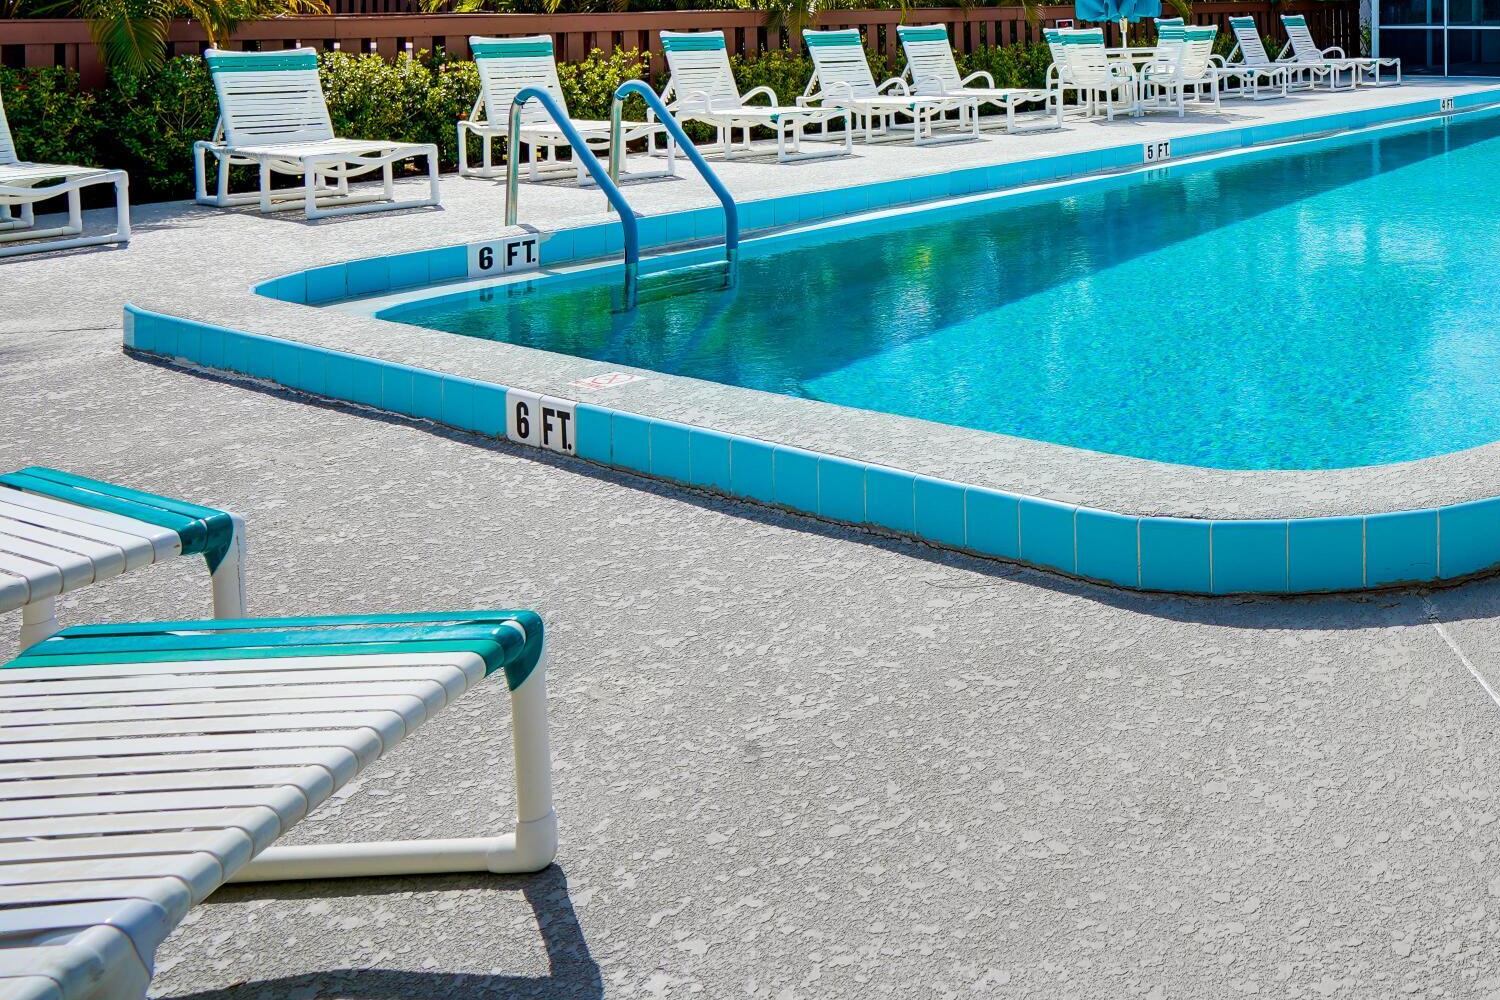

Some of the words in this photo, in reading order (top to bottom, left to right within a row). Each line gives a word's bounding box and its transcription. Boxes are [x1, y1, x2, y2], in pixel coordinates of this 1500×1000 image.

[1147, 144, 1154, 160] 5
[1158, 142, 1170, 158] FT.
[479, 246, 494, 271] 6
[507, 239, 537, 267] FT.
[516, 401, 530, 439] 6
[542, 406, 572, 451] FT.
